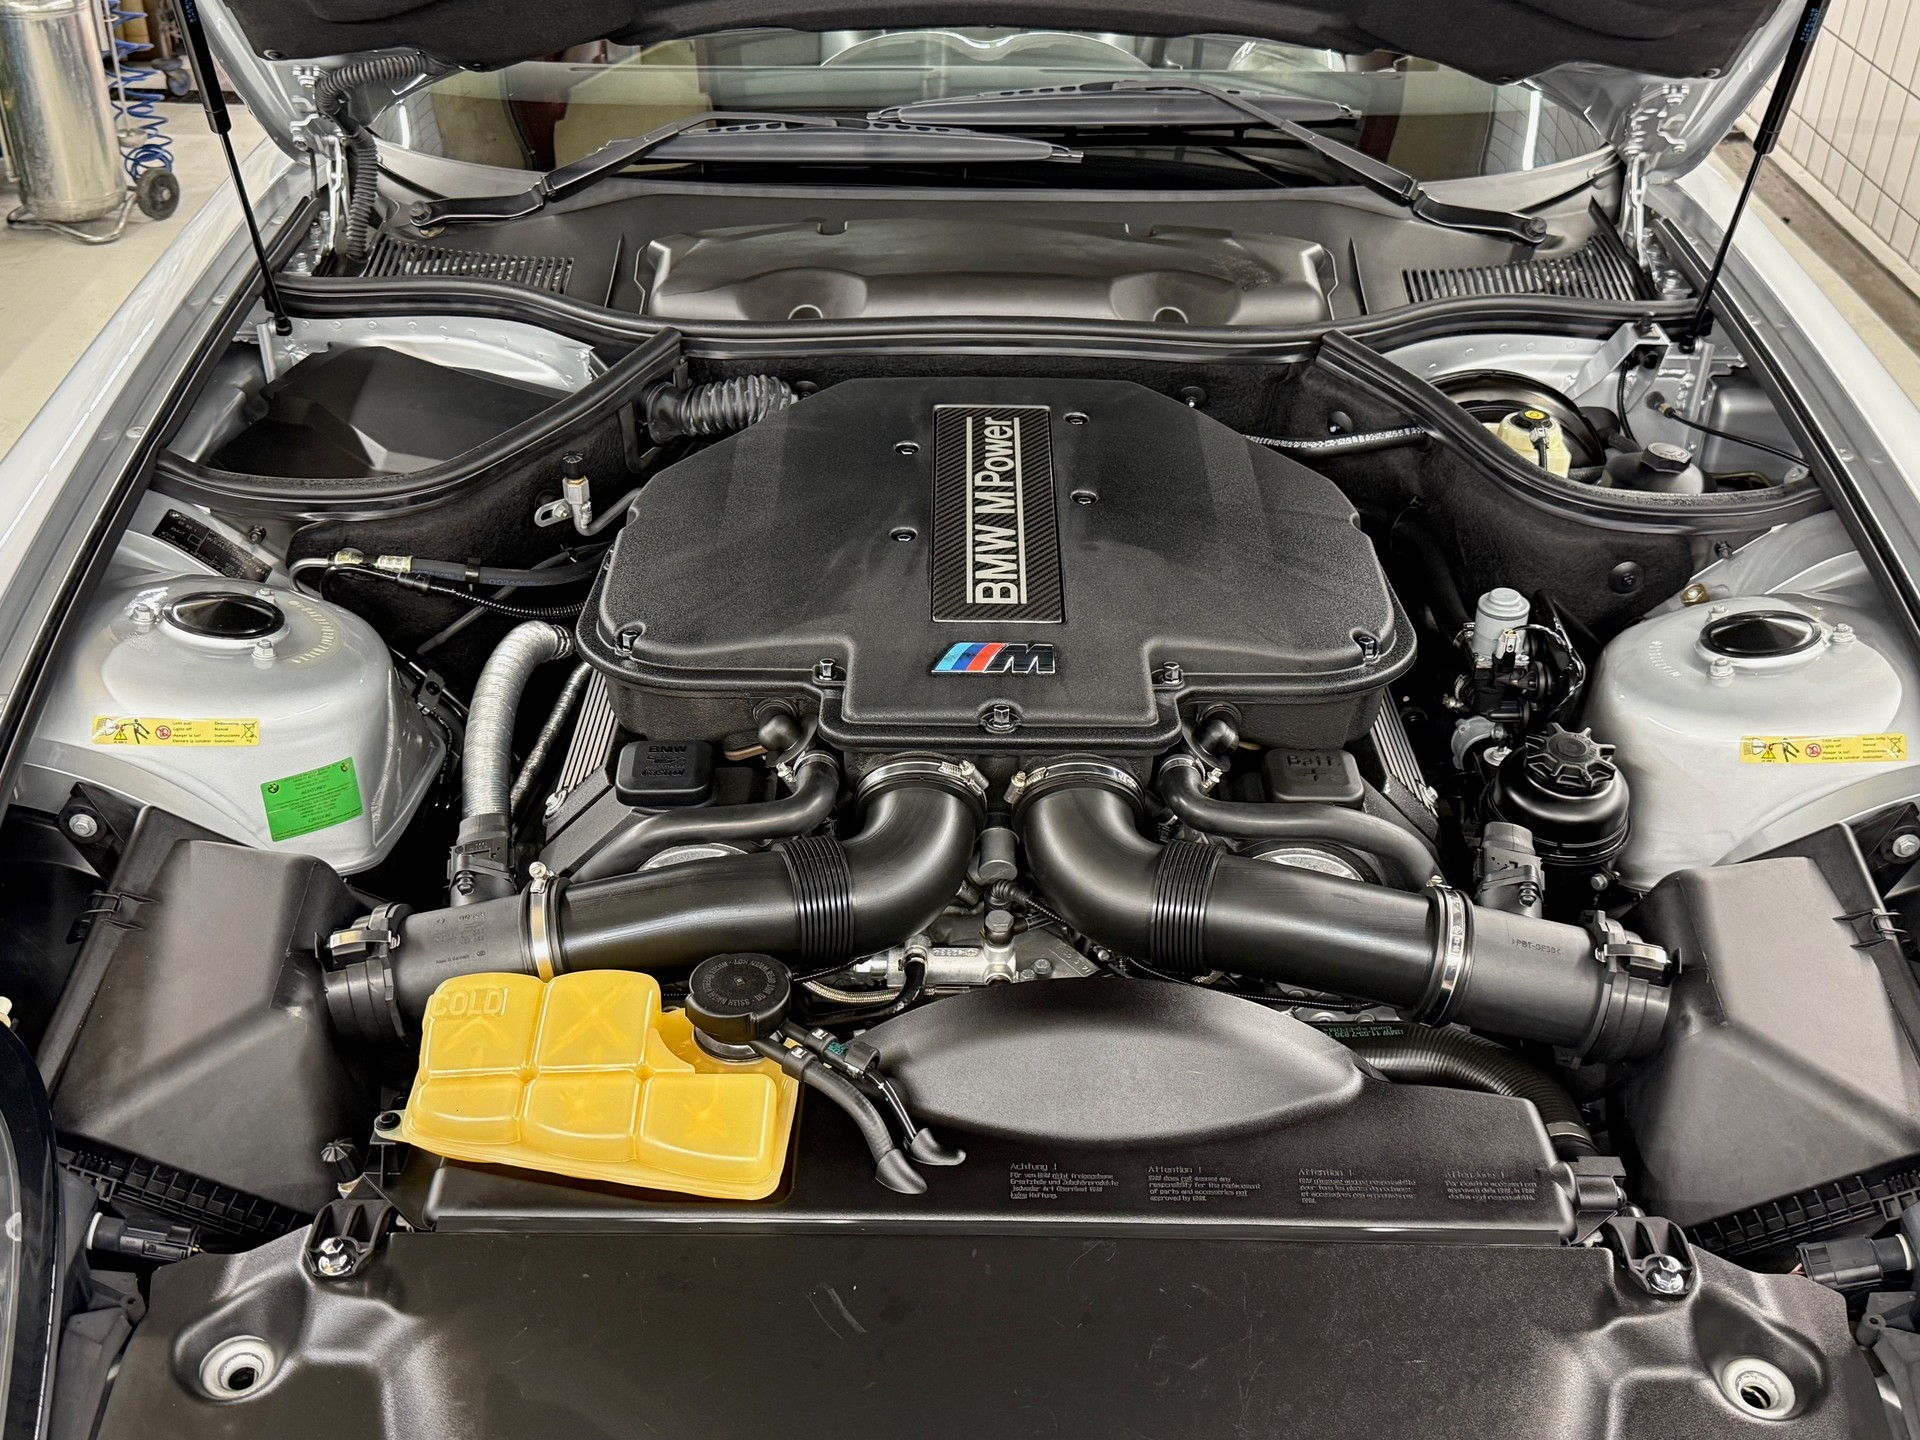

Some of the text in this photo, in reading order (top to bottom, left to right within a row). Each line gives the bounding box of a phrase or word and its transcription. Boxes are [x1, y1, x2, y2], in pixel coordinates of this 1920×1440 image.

[975, 524, 1018, 604] BMW
[984, 643, 1055, 673] M
[648, 745, 688, 753] BMW
[428, 989, 505, 1016] COLD
[1010, 1163, 1048, 1171] Achtung
[1148, 1165, 1193, 1174] Attention
